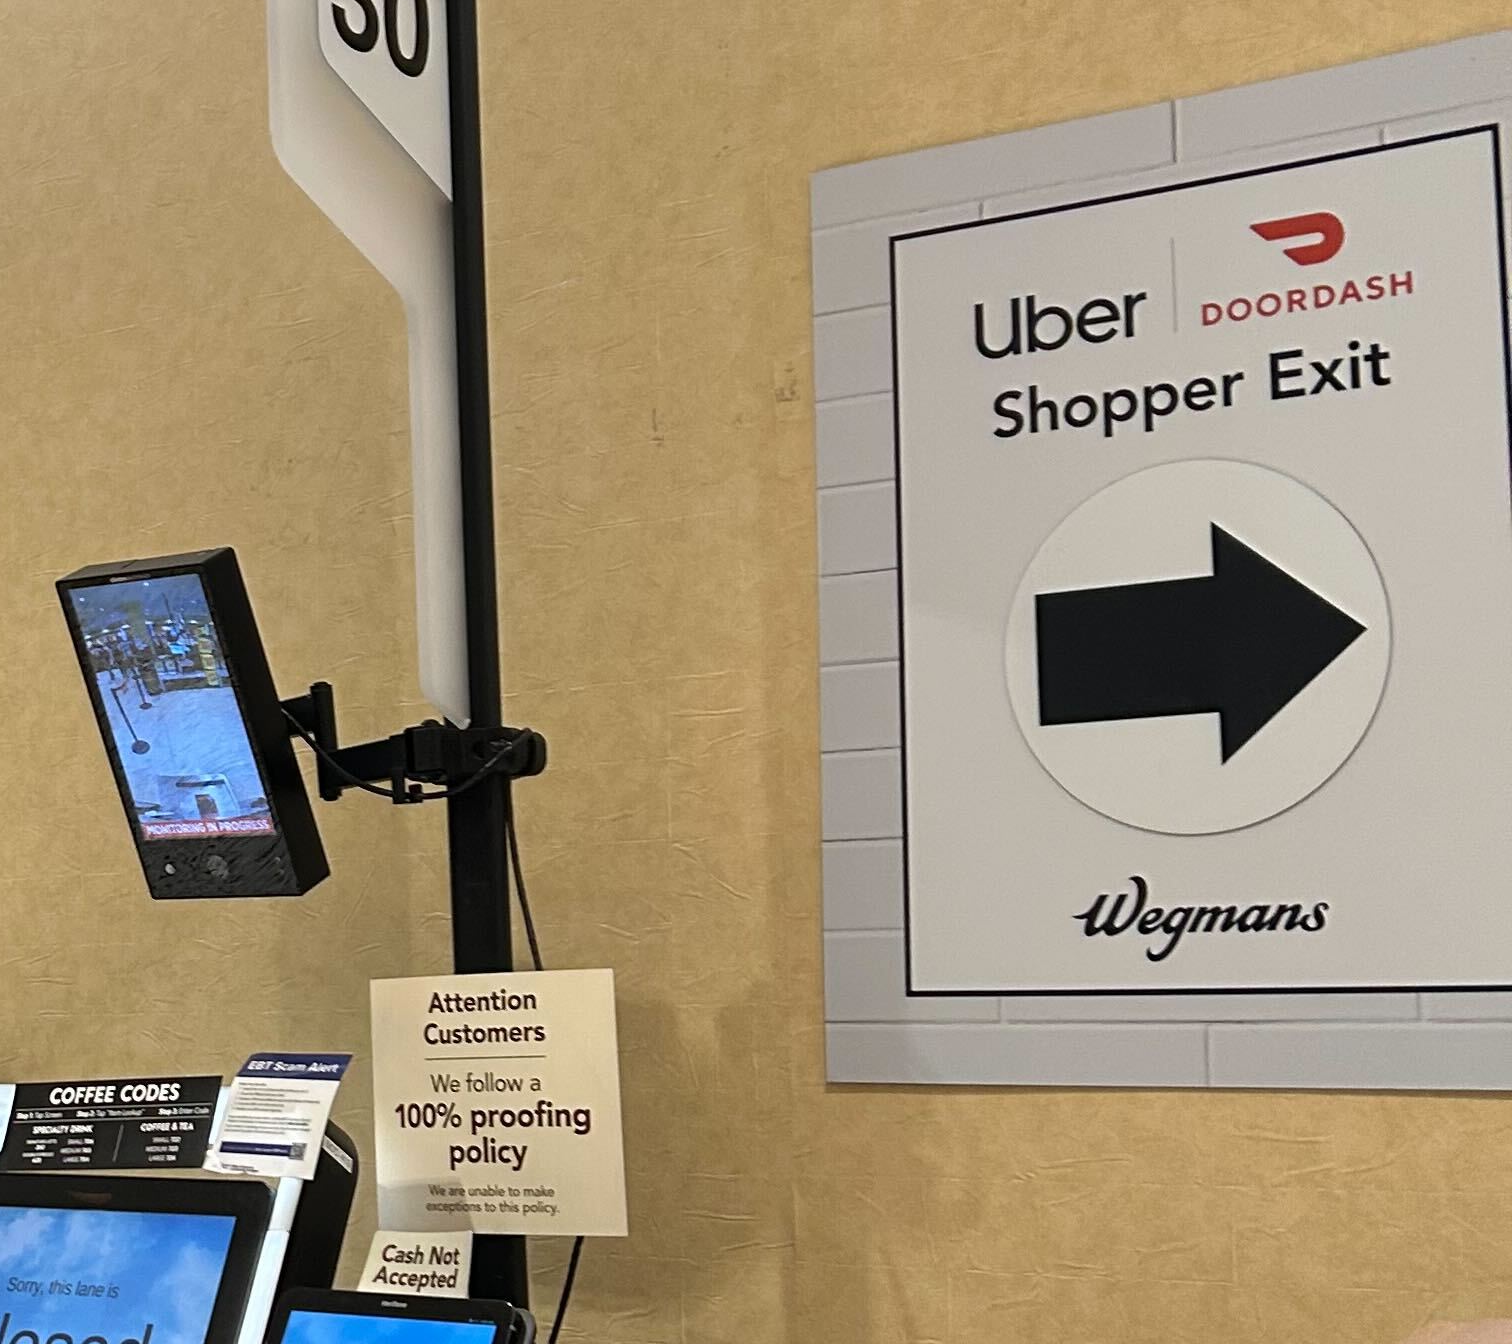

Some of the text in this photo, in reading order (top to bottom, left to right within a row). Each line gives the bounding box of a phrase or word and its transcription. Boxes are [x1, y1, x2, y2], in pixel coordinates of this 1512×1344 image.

[1201, 271, 1414, 326] DOORDASH
[974, 291, 1148, 359] Uber
[992, 340, 1392, 438] Shopper Exit
[147, 822, 206, 834] MONITORING
[218, 819, 268, 832] PROGRESS
[1072, 875, 1330, 962] Wegmans
[429, 988, 537, 1014] Attention
[424, 1022, 546, 1045] Customers
[308, 1062, 340, 1073] Alert
[49, 1083, 181, 1105] COFFEE CODES
[430, 1072, 542, 1093] We follow a
[395, 1100, 592, 1136] 100% proofing
[449, 1136, 529, 1171] policy
[429, 1184, 555, 1197] We are unable to make
[425, 1199, 560, 1216] exceptions to this policy.
[382, 1244, 460, 1265] Cash Not
[6, 1276, 120, 1299] Sorry, this lane is
[372, 1267, 458, 1292] Accepted
